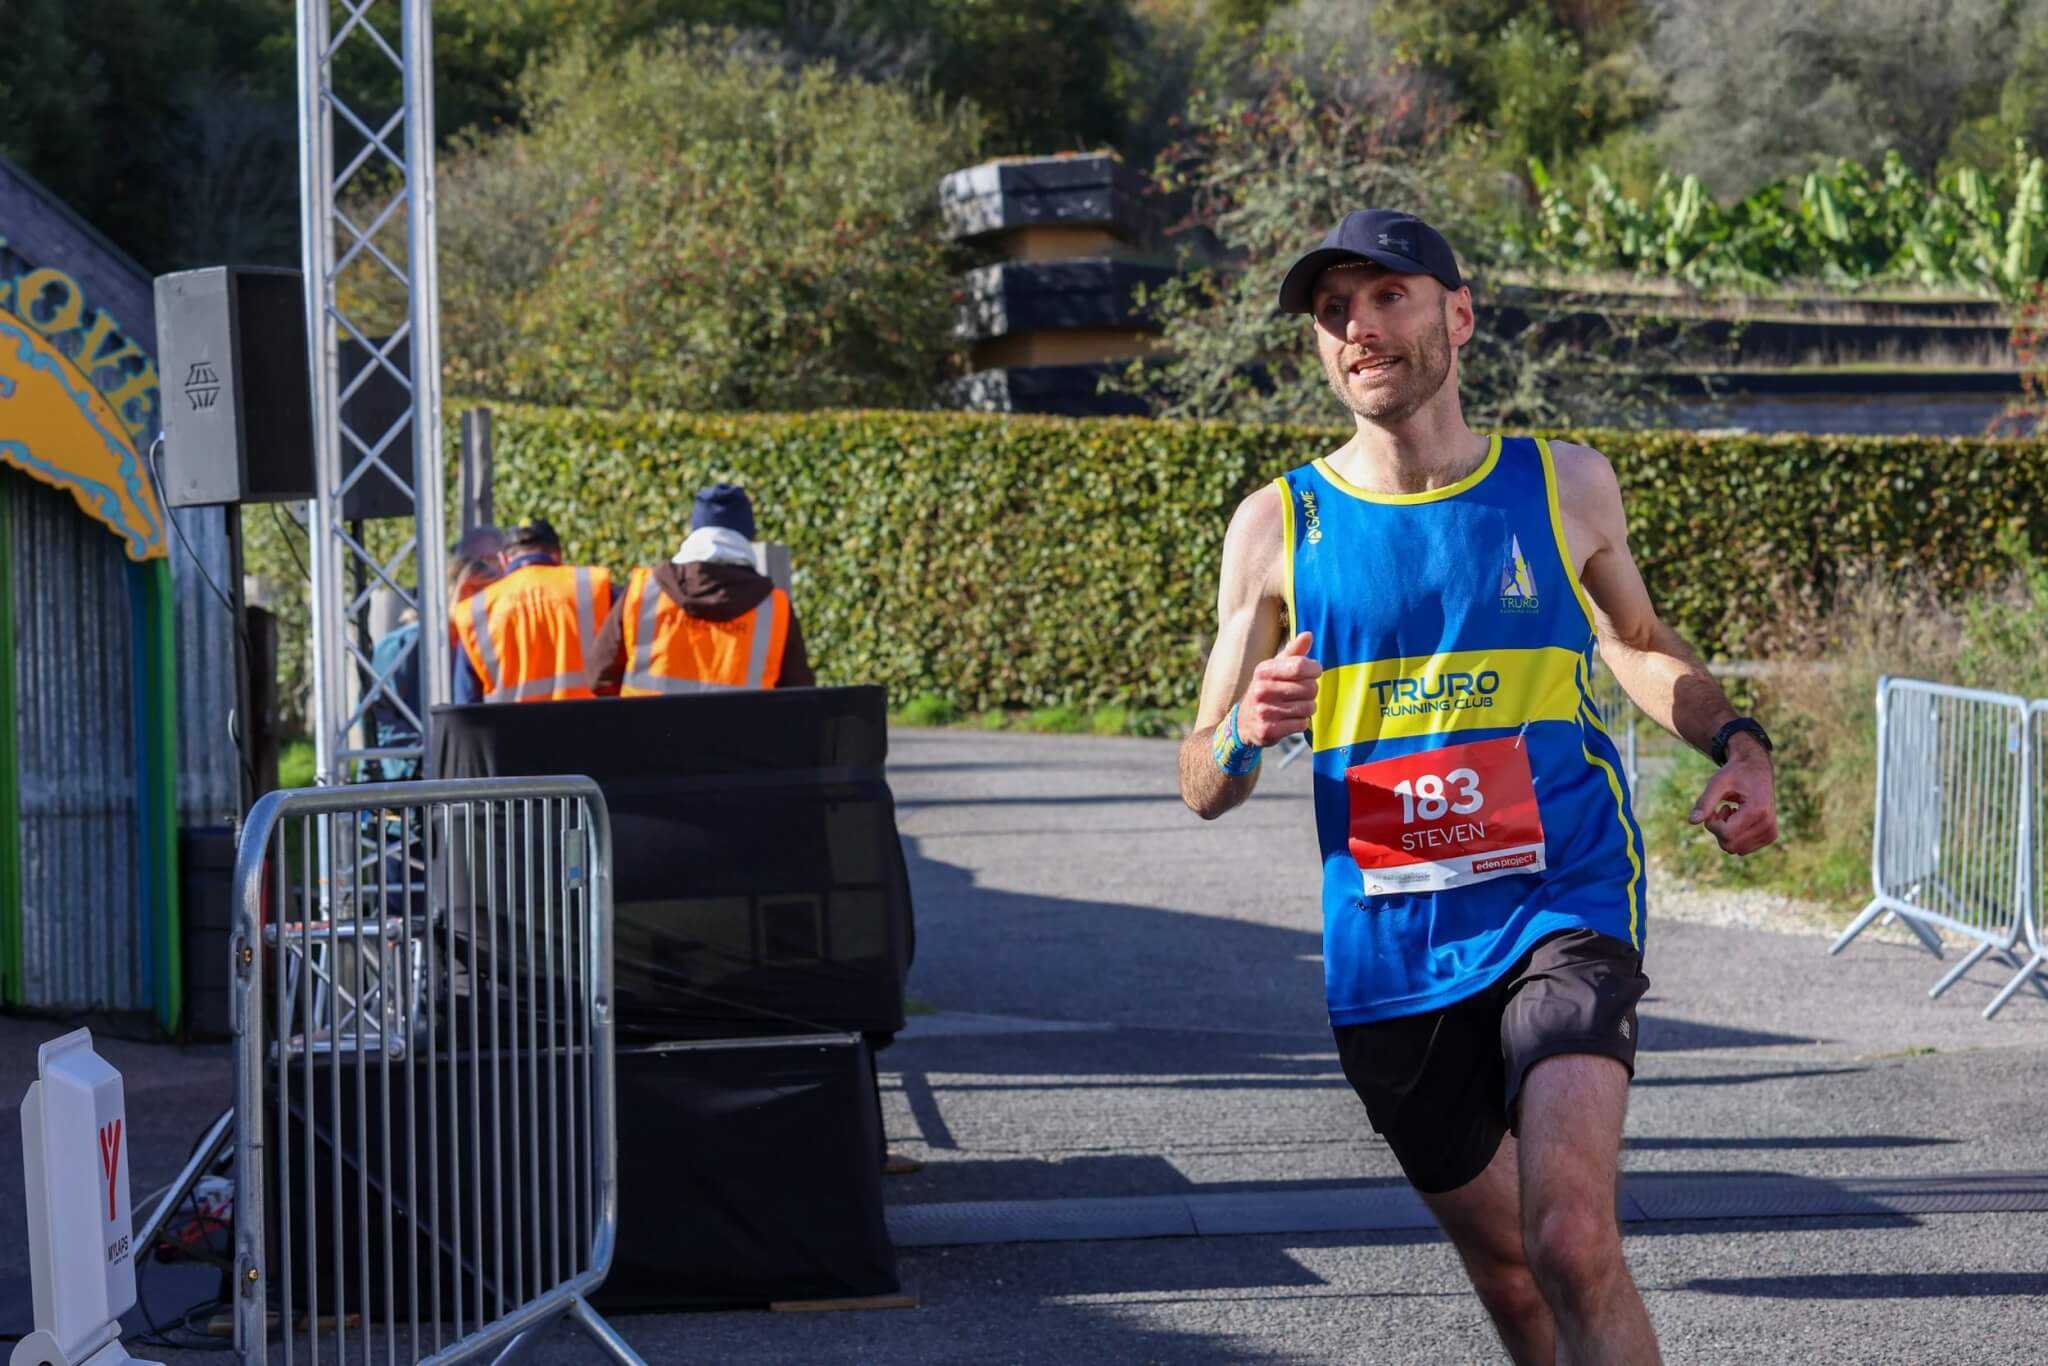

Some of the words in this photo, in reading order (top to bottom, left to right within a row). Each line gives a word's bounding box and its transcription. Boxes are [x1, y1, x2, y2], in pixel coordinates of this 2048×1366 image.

[1500, 597, 1539, 608] TRURO
[1369, 671, 1500, 705] TRURO
[1380, 699, 1450, 717] RUNNING
[1454, 696, 1493, 710] CLUB
[1393, 768, 1484, 825] 183
[1401, 821, 1486, 851] STEVEN
